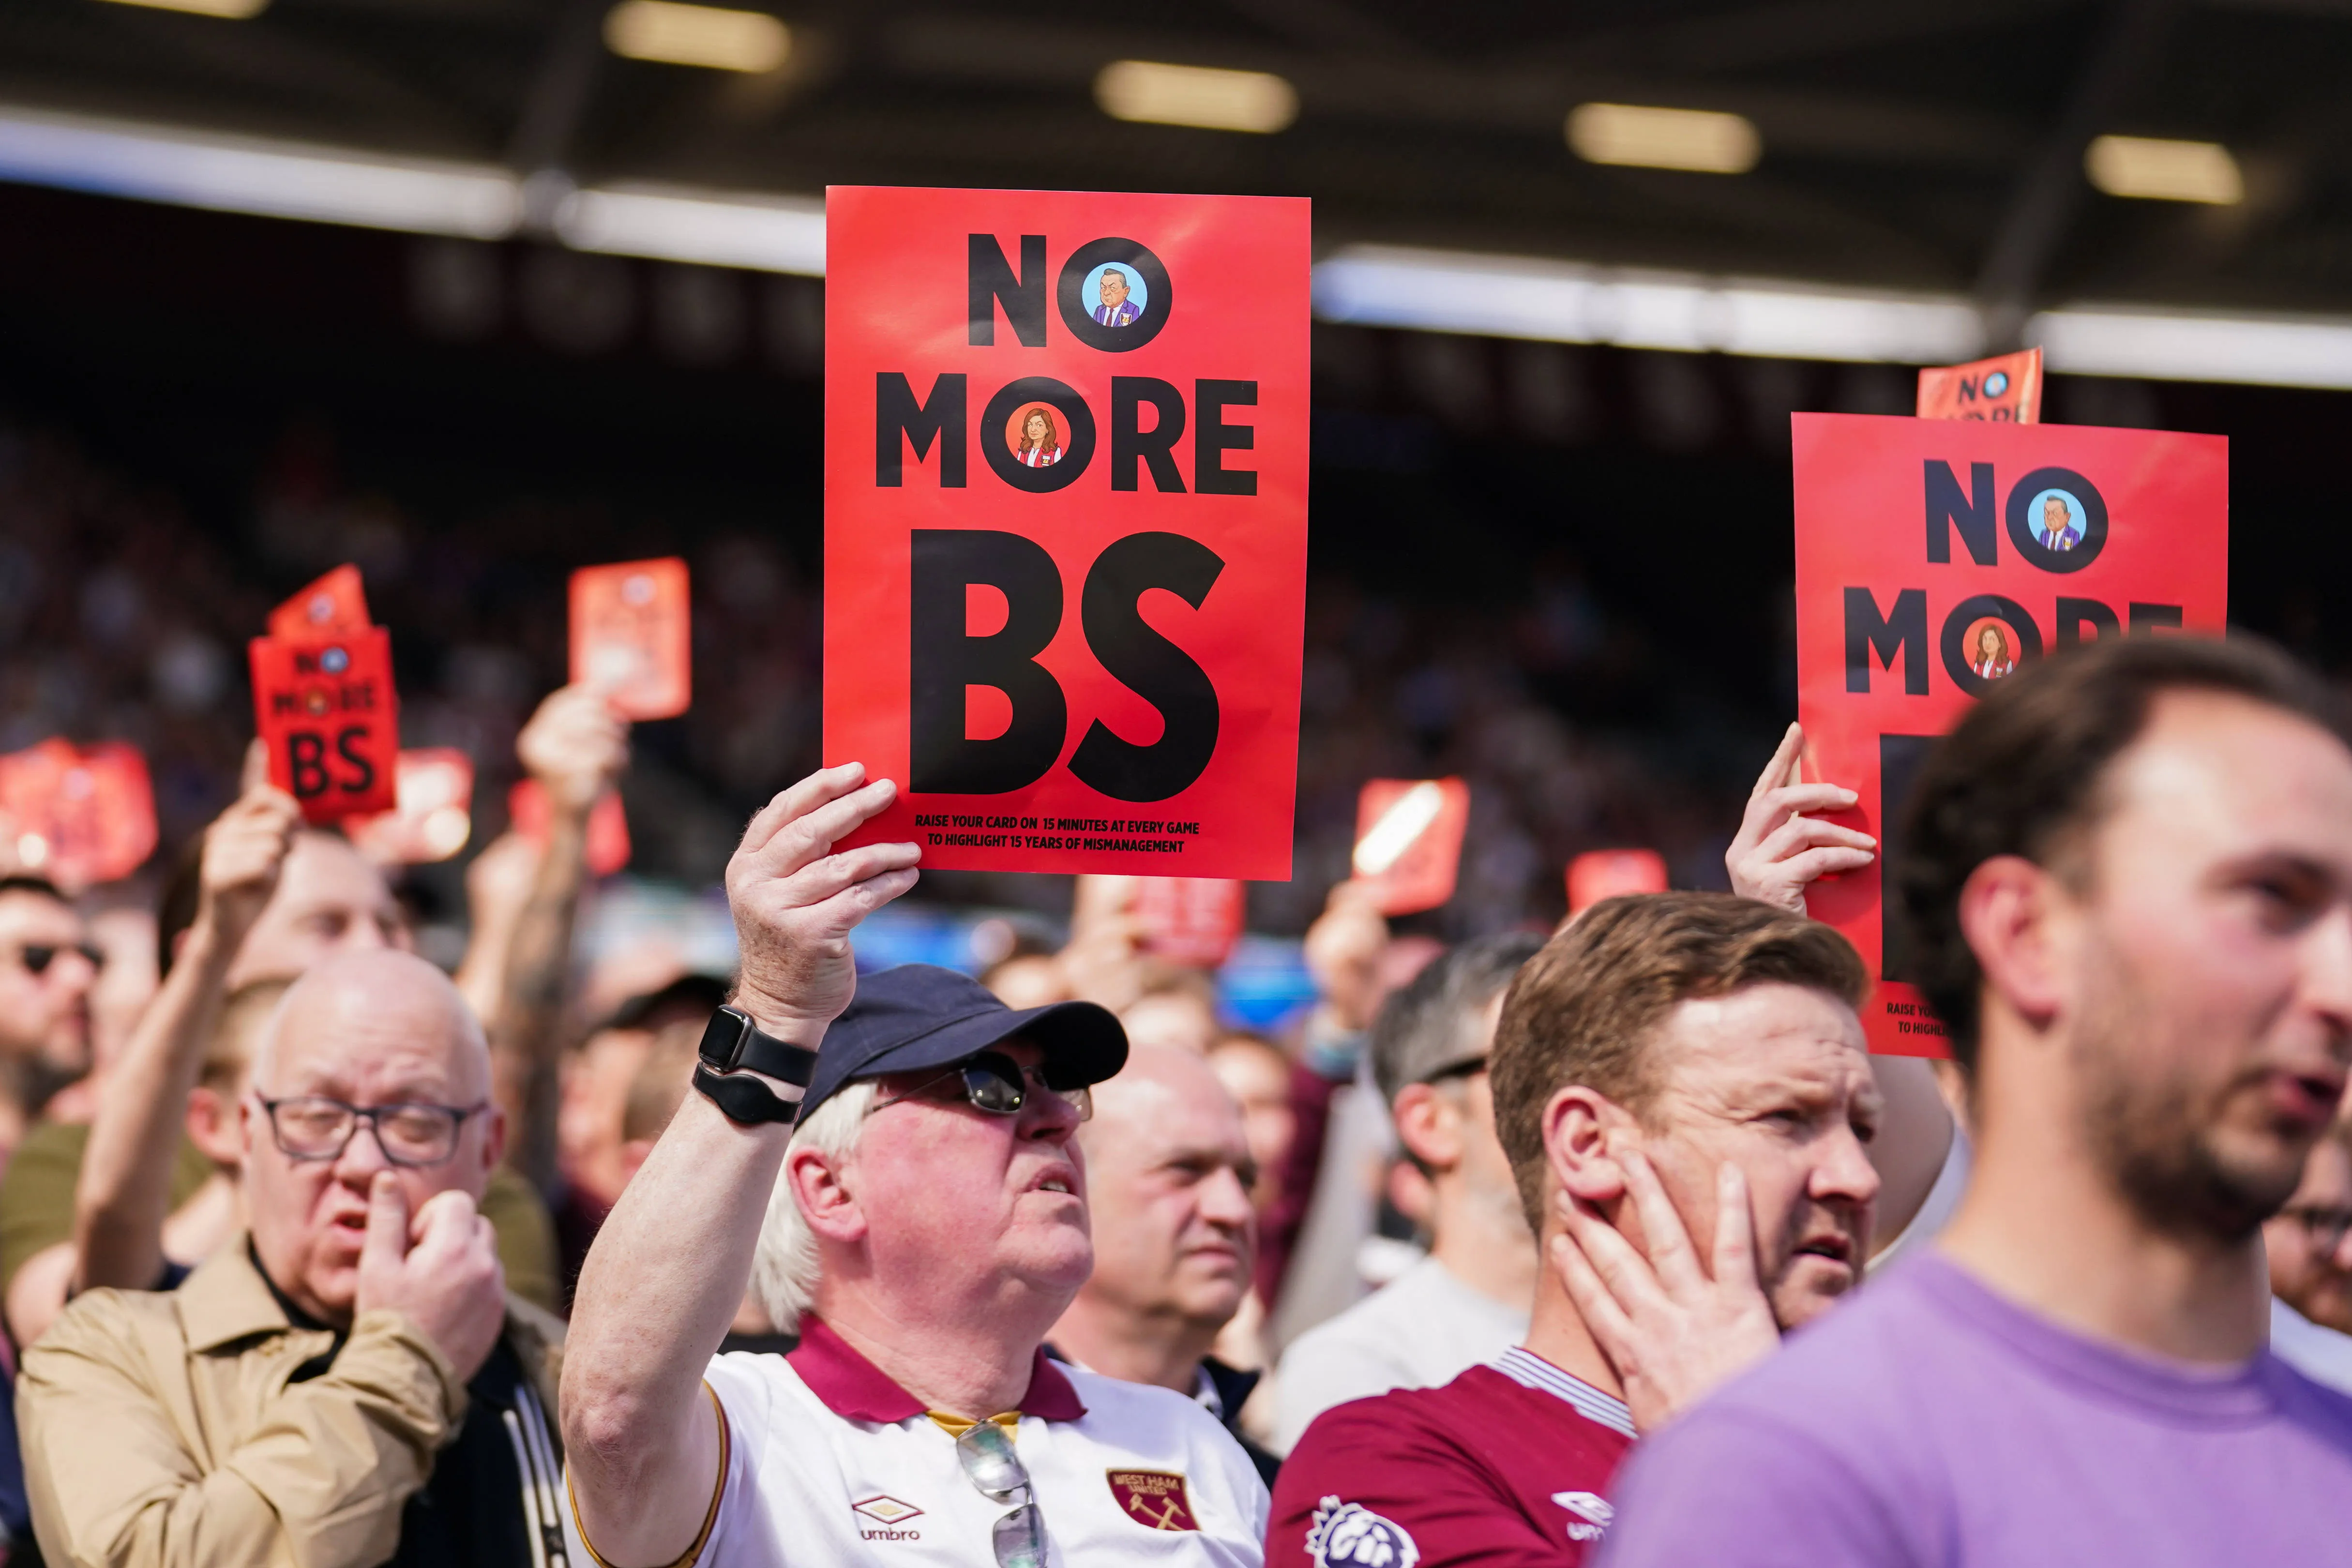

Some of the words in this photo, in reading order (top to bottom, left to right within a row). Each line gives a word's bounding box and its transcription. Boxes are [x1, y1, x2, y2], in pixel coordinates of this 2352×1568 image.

[968, 234, 1173, 353] NO
[1959, 372, 2009, 405] NO
[876, 372, 1258, 496] MORE
[1923, 459, 2109, 574] NO
[910, 529, 1226, 803] BS
[288, 726, 375, 798] BS
[915, 814, 949, 827] RAISE
[951, 815, 983, 828] YOUR
[986, 816, 1018, 829] CARD
[1020, 817, 1038, 829] ON
[1043, 818, 1055, 830] 15
[1057, 818, 1108, 832] MINUTES
[1111, 820, 1125, 832] AT
[1128, 821, 1164, 833] EVERY
[1166, 822, 1200, 834] GAME
[928, 833, 942, 845] TO
[945, 834, 1008, 847] HIGHLIGHT
[1010, 836, 1022, 847] 15
[1025, 836, 1063, 849] YEARS
[1066, 838, 1081, 850] OF
[1083, 838, 1185, 852] MISMANAGEMENT
[1887, 1002, 1915, 1015] RAISE
[1899, 1021, 1911, 1033] TO
[1114, 1474, 1146, 1485] WEST
[1146, 1476, 1179, 1489] HAM
[861, 1528, 920, 1540] umbro
